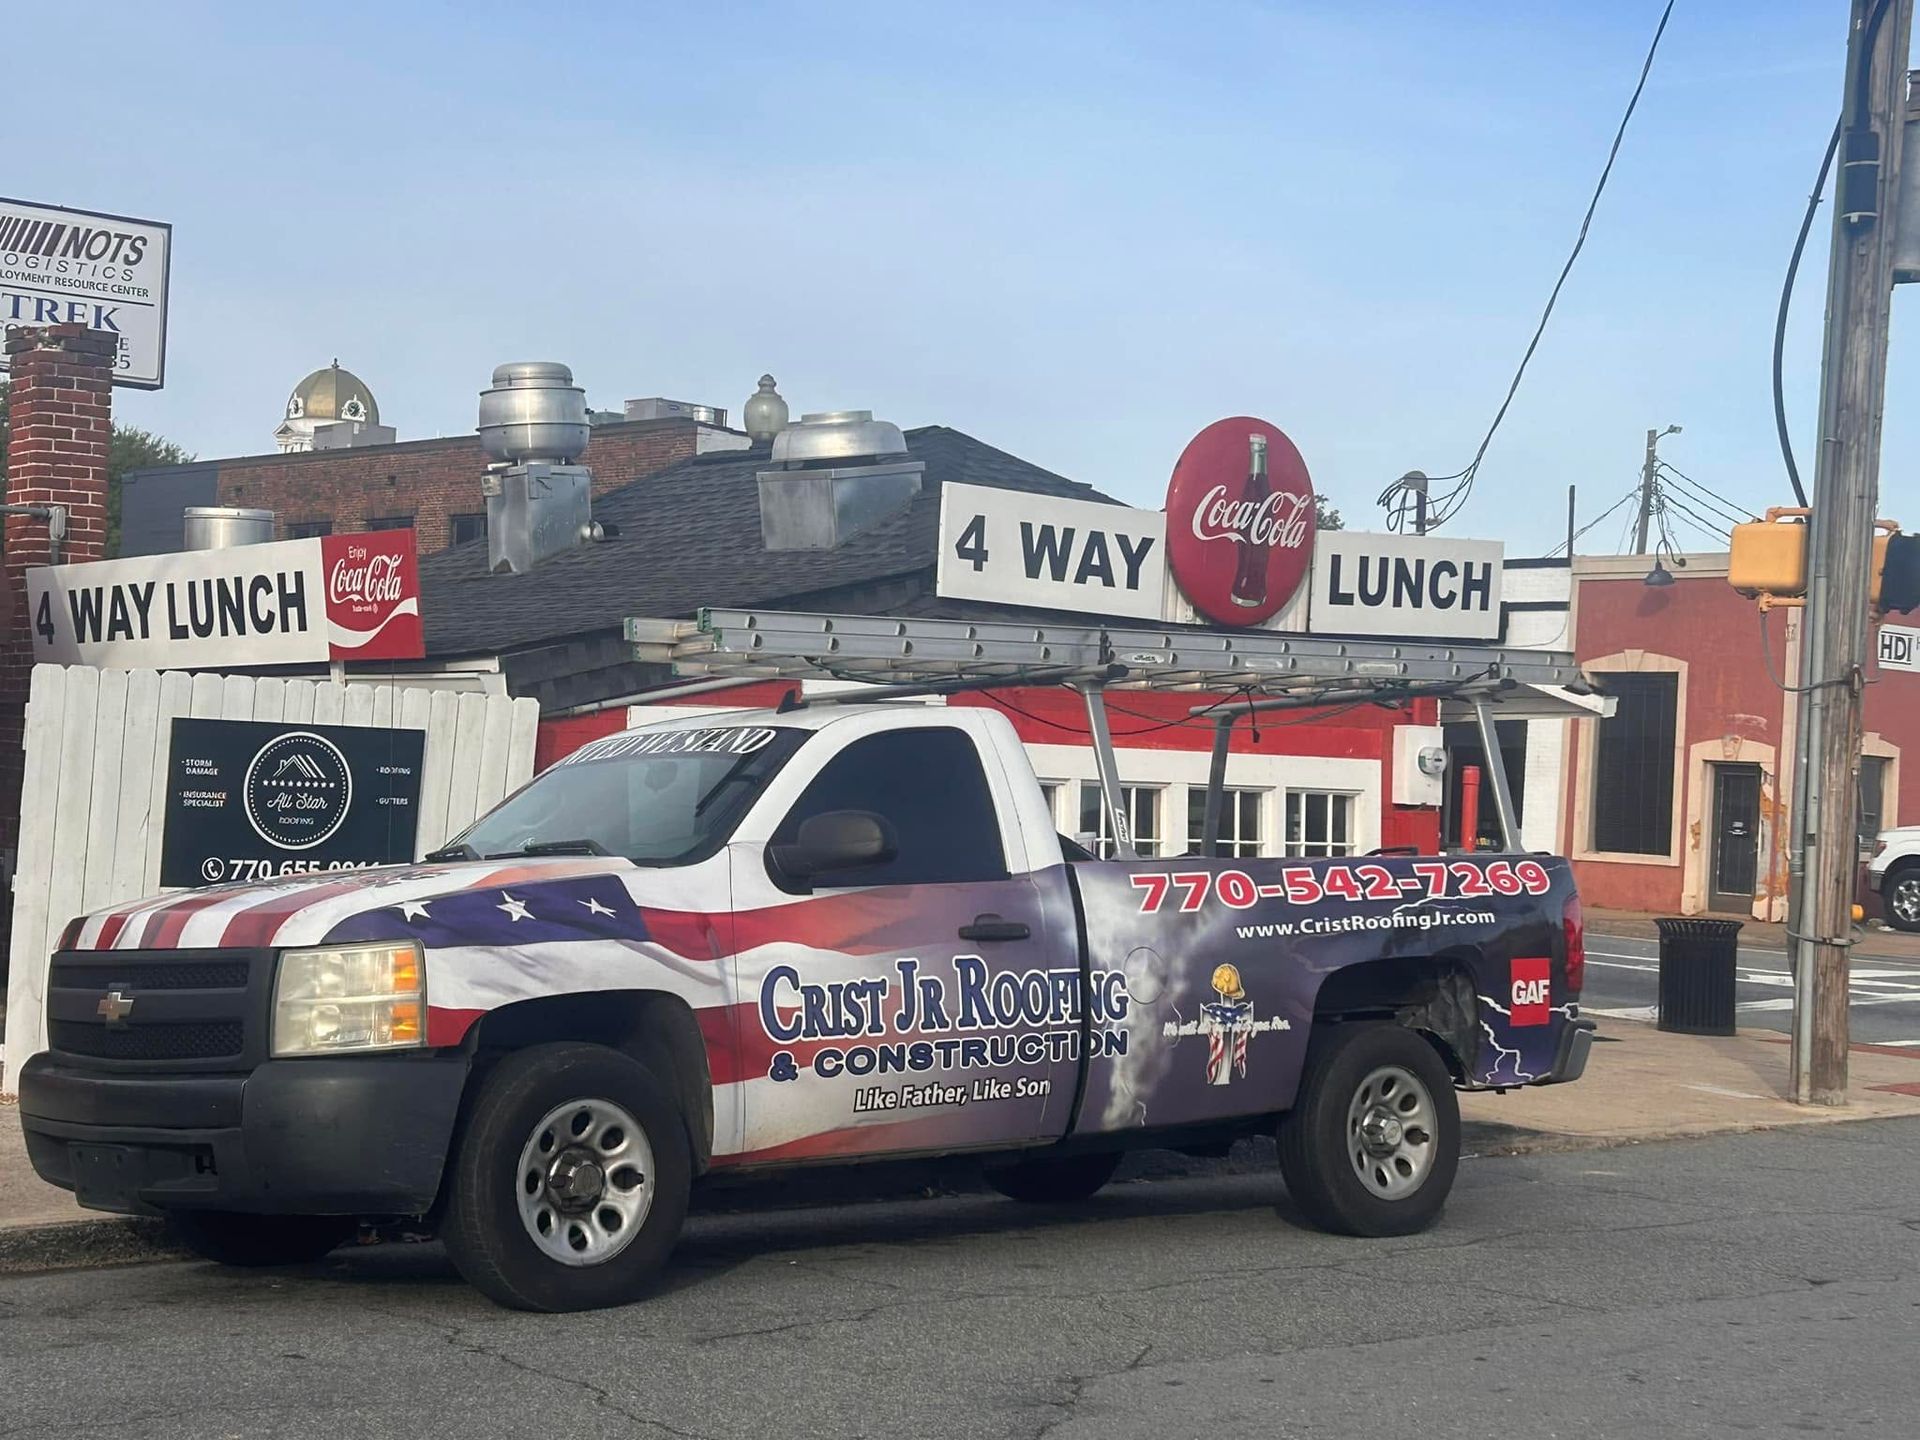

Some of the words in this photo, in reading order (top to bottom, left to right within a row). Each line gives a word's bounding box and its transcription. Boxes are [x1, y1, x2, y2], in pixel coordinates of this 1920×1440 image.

[59, 226, 148, 267] NOTS
[2, 252, 134, 283] OGISTICS
[0, 269, 52, 285] LOYMENT
[54, 276, 108, 293] RESOURCE
[110, 283, 149, 298] CENTER
[1, 292, 121, 332] TREK
[1192, 485, 1311, 548] Coca-Cola
[954, 514, 989, 572] 4
[1019, 521, 1155, 590] WAY
[1328, 554, 1492, 611] LUNCH
[330, 554, 403, 604] Coca-Cola
[35, 591, 55, 645] 4
[68, 581, 156, 644] WAY
[166, 570, 308, 640] LUNCH
[1879, 634, 1913, 662] HDI
[185, 758, 213, 767] STORM
[185, 767, 219, 776] DAMAGE
[183, 790, 227, 800] INSURANCE
[183, 798, 225, 808] SPECIALIST
[266, 792, 293, 812] All
[295, 792, 328, 810] Star
[1129, 861, 1551, 914] 770-542-7269
[1236, 910, 1496, 938] www.CristRoofingJr.com
[1511, 979, 1550, 1005] GAF
[768, 1050, 800, 1082] &
[854, 1088, 897, 1113] Like
[900, 1082, 968, 1107] Father,
[971, 1077, 1012, 1102] Like
[1015, 1077, 1051, 1099] Son
